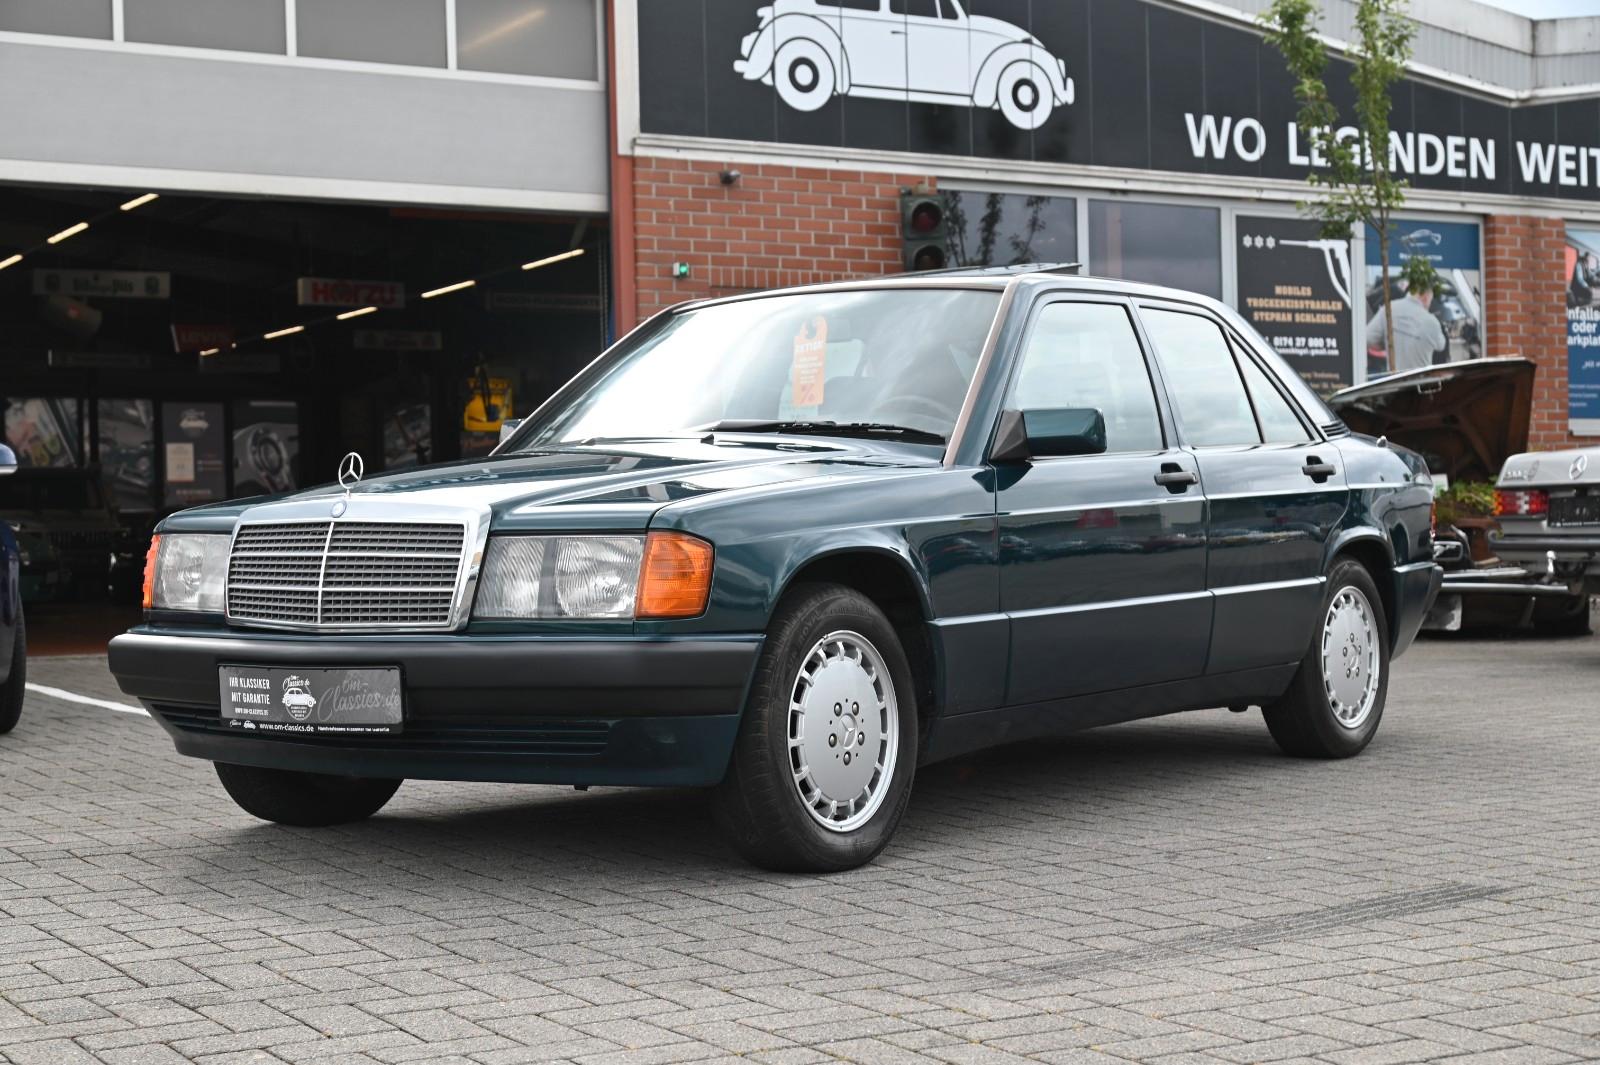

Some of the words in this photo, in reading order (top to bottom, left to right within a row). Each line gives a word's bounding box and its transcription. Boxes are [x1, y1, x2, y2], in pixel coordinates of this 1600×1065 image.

[1184, 112, 1266, 163] WO
[1516, 140, 1600, 189] WEIT
[1274, 285, 1313, 296] MOBILES
[1566, 306, 1600, 321] nfalls
[1572, 320, 1598, 334] oder
[239, 677, 270, 690] KLASSIKER
[231, 691, 242, 702] MIT
[242, 692, 270, 704] GARANTIE
[259, 723, 315, 732] www.om-classics.de
